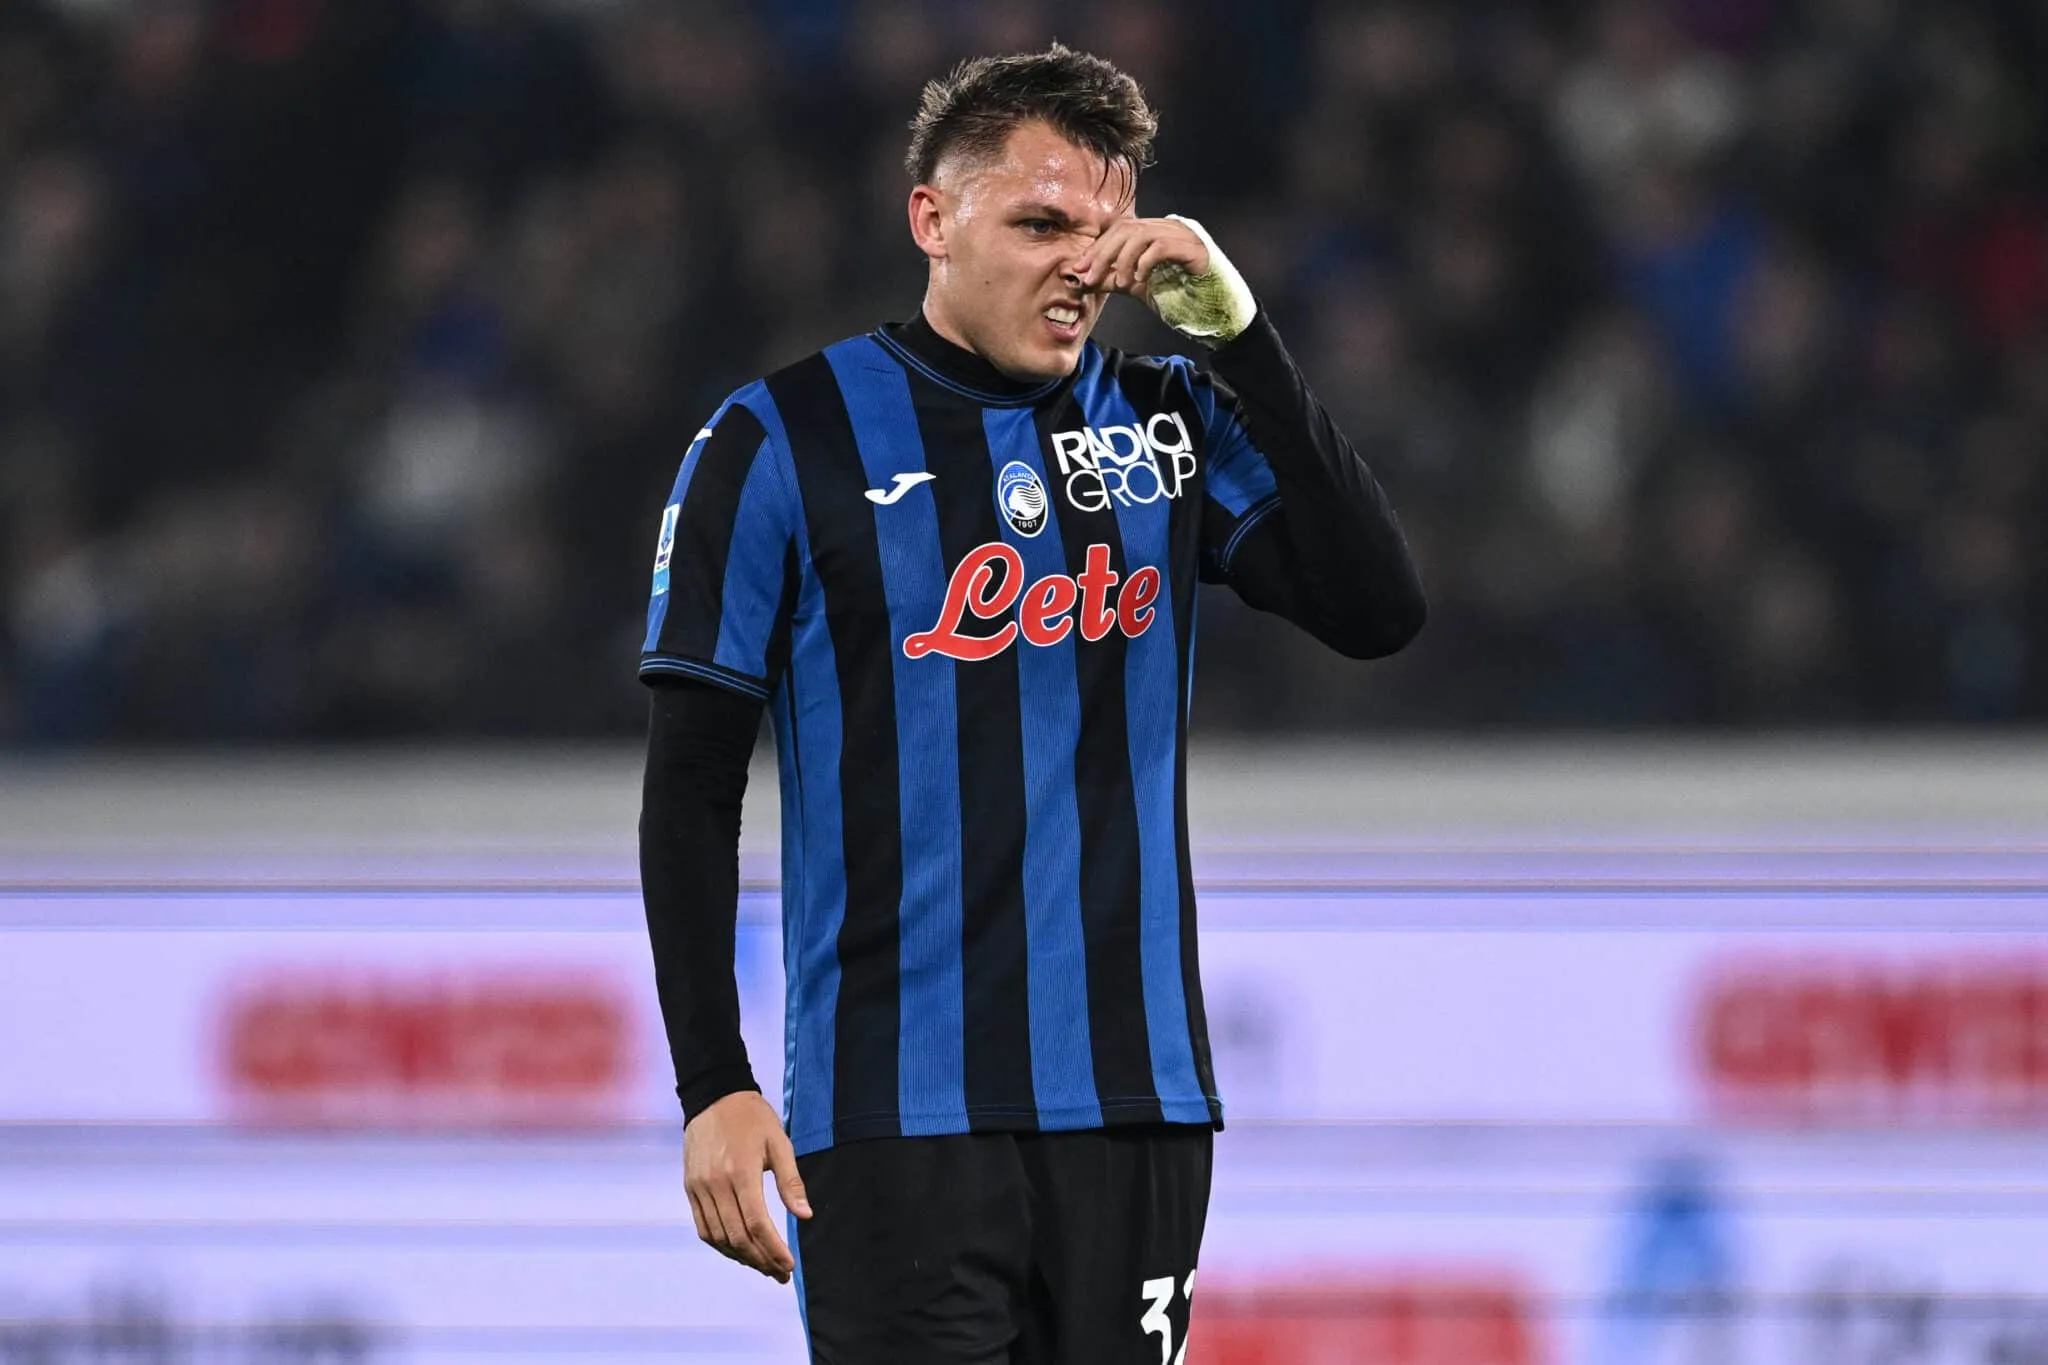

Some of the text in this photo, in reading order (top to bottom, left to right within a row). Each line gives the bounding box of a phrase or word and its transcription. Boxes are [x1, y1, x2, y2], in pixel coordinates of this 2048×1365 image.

[1051, 411, 1192, 475] RADICI
[1066, 452, 1196, 512] GROUP
[1018, 519, 1037, 528] 1907
[903, 542, 1161, 662] Lete
